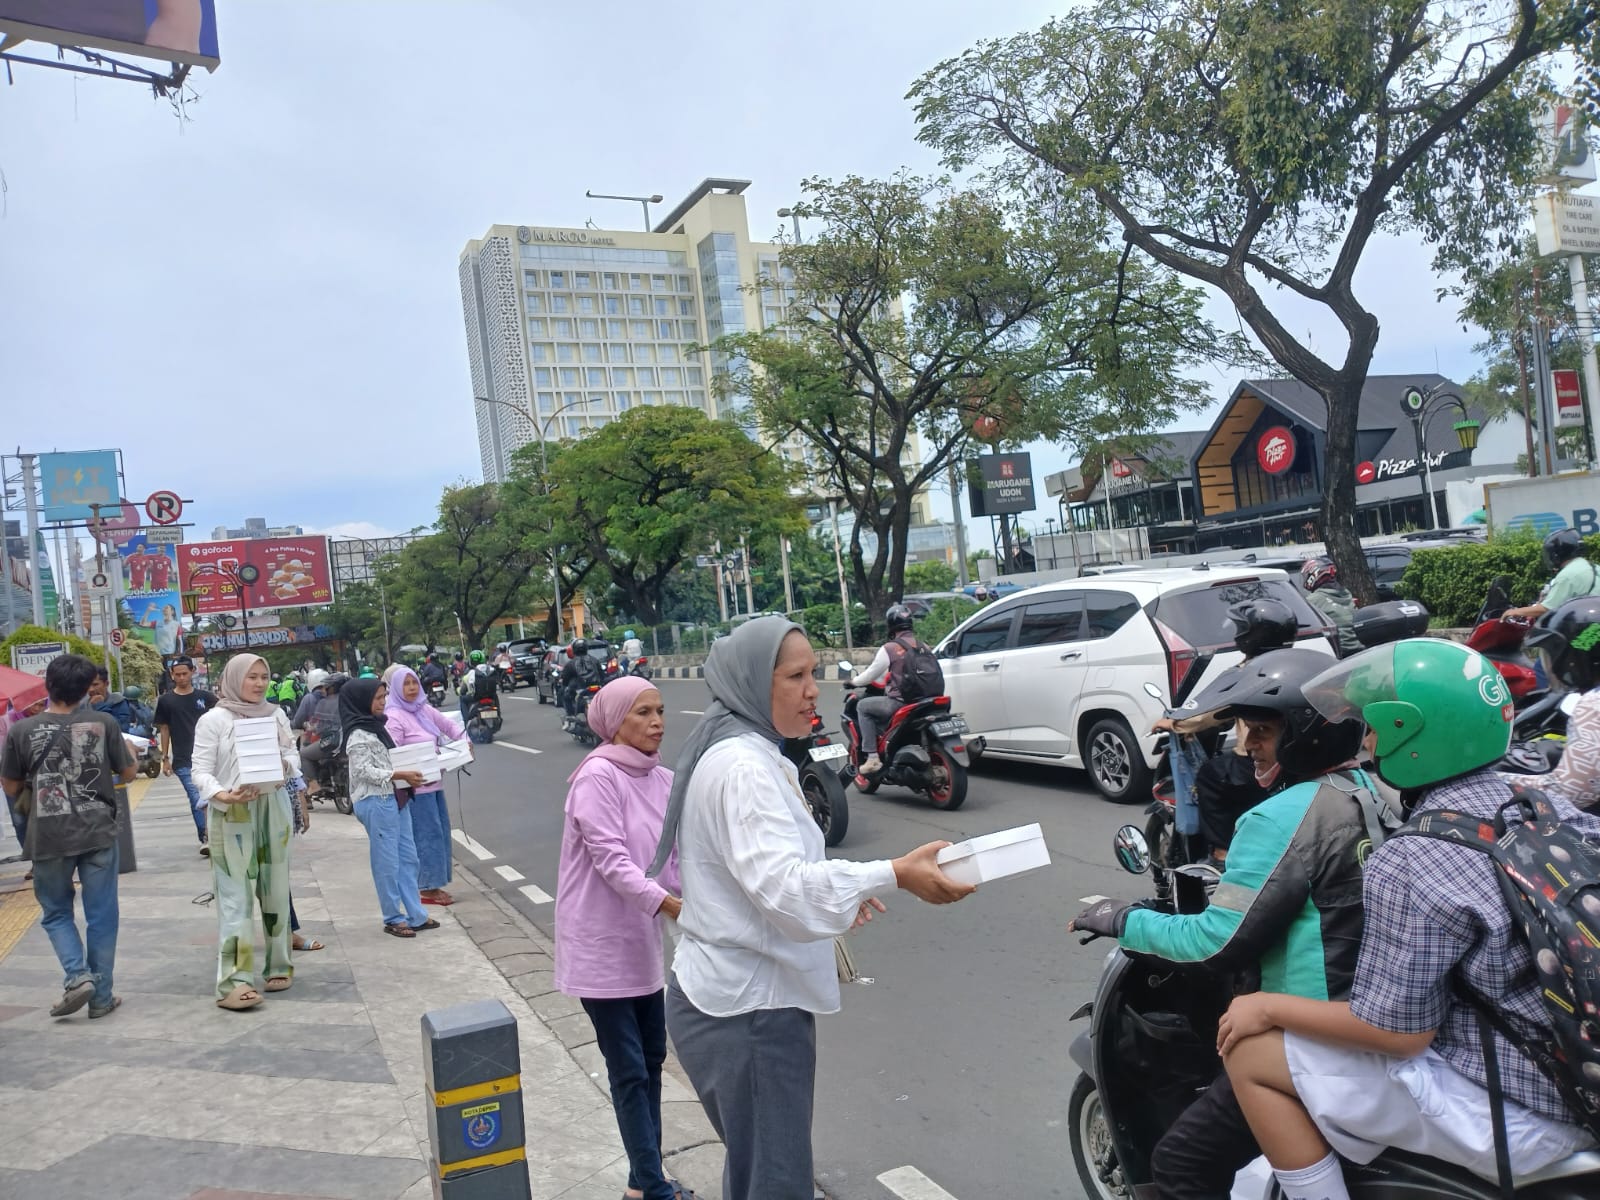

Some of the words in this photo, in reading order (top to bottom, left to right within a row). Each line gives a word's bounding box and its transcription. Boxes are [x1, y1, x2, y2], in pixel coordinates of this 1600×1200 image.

[1377, 458, 1417, 480] Pizza
[1420, 450, 1449, 467] Hut
[987, 478, 1031, 489] MARUGAME
[1000, 488, 1022, 497] UDON
